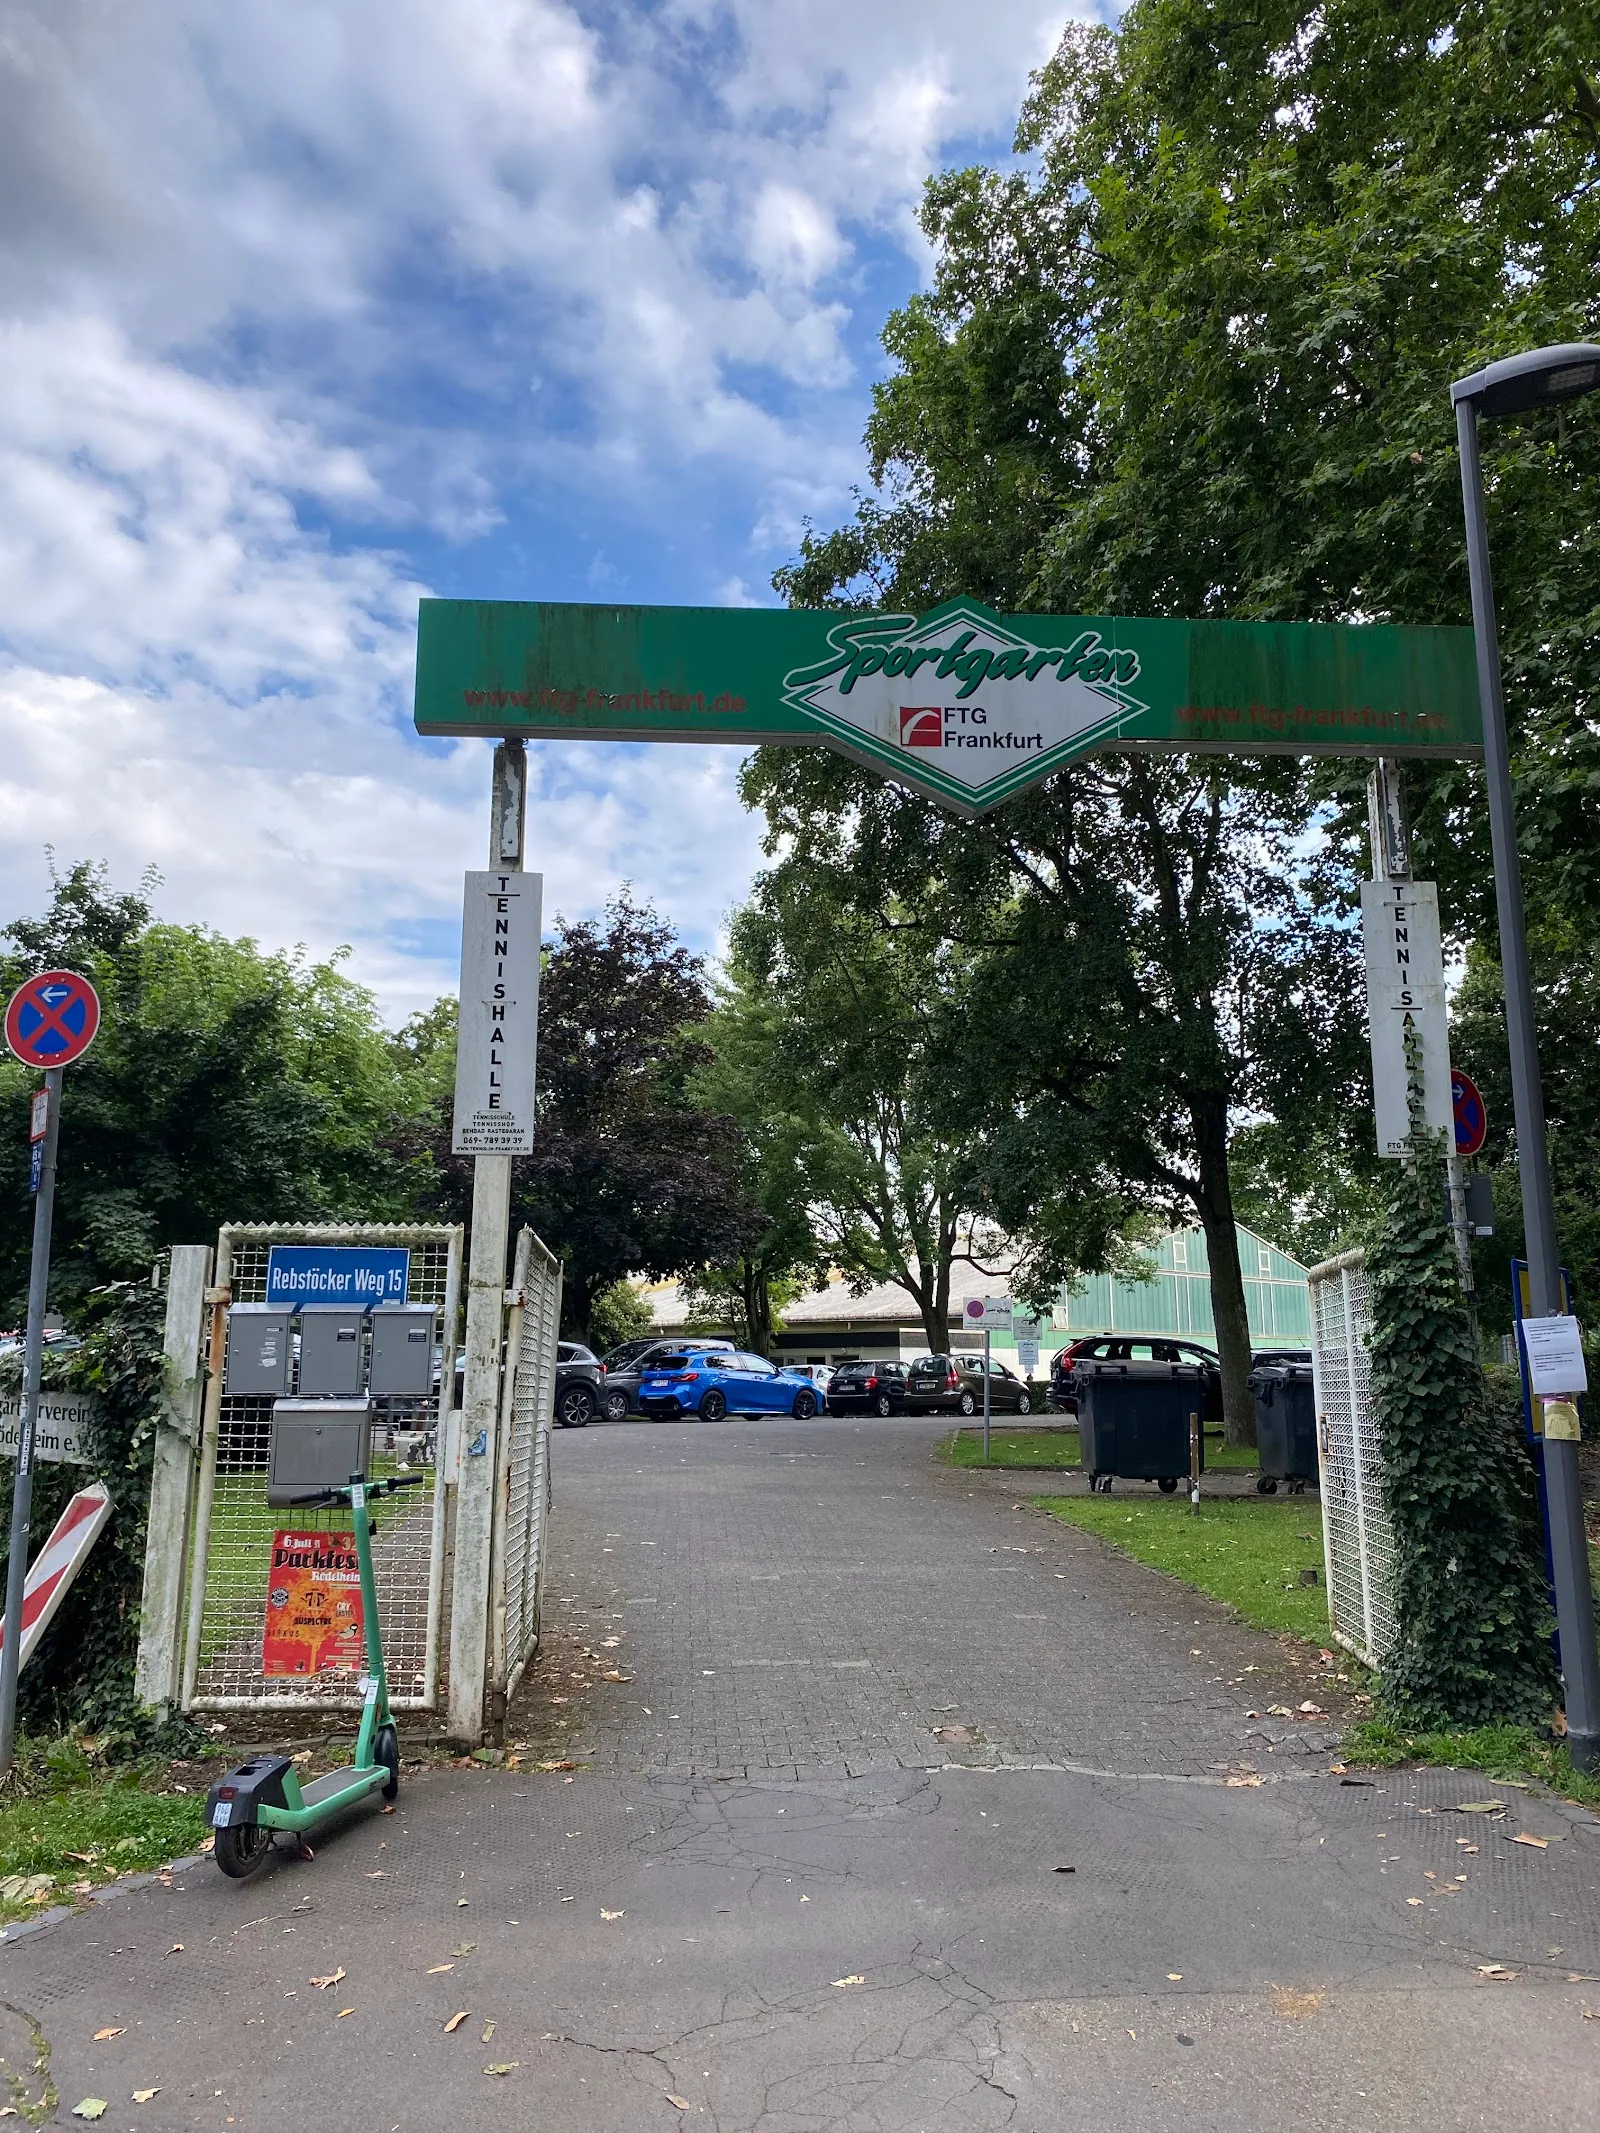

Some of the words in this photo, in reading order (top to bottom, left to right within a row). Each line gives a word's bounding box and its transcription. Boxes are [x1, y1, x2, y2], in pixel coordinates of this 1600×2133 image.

[783, 615, 1137, 699] Sportgarten
[944, 707, 987, 724] FTG
[944, 731, 1043, 749] Frankfurt
[489, 876, 510, 1109] TENNISHALLE
[484, 1136, 498, 1144] 789
[272, 1267, 352, 1290] Rebstöcker
[354, 1268, 385, 1296] Weg
[388, 1269, 403, 1291] 15
